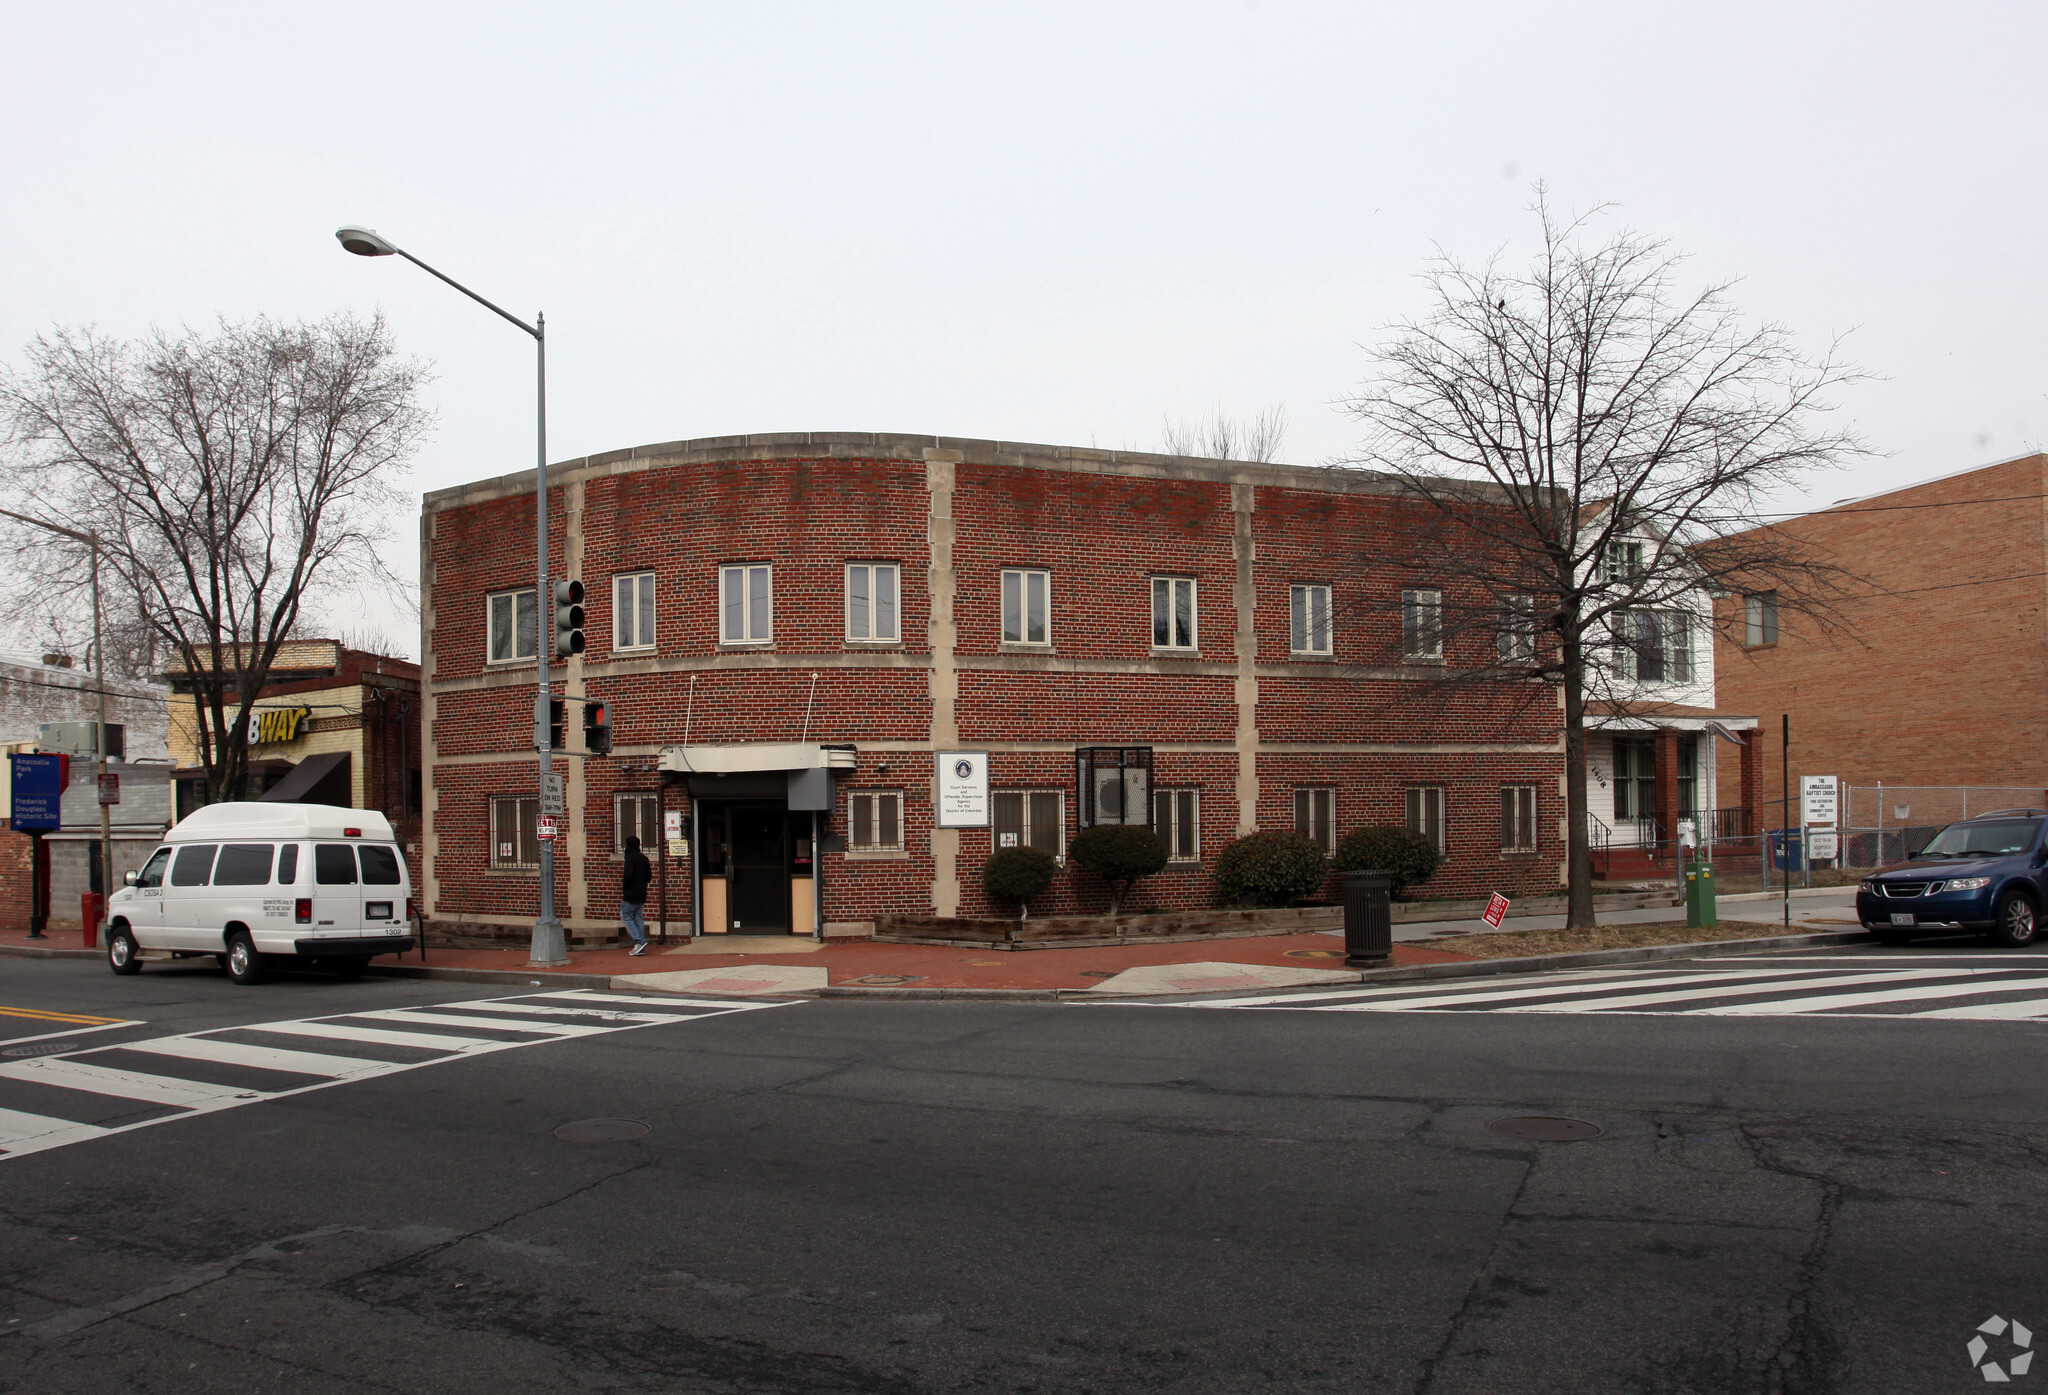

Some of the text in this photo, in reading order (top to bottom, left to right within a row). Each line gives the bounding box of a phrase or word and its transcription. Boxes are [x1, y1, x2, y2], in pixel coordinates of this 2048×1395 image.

[228, 708, 307, 744] BWAY
[1591, 766, 1606, 788] 1408
[144, 889, 159, 897] CSOSA
